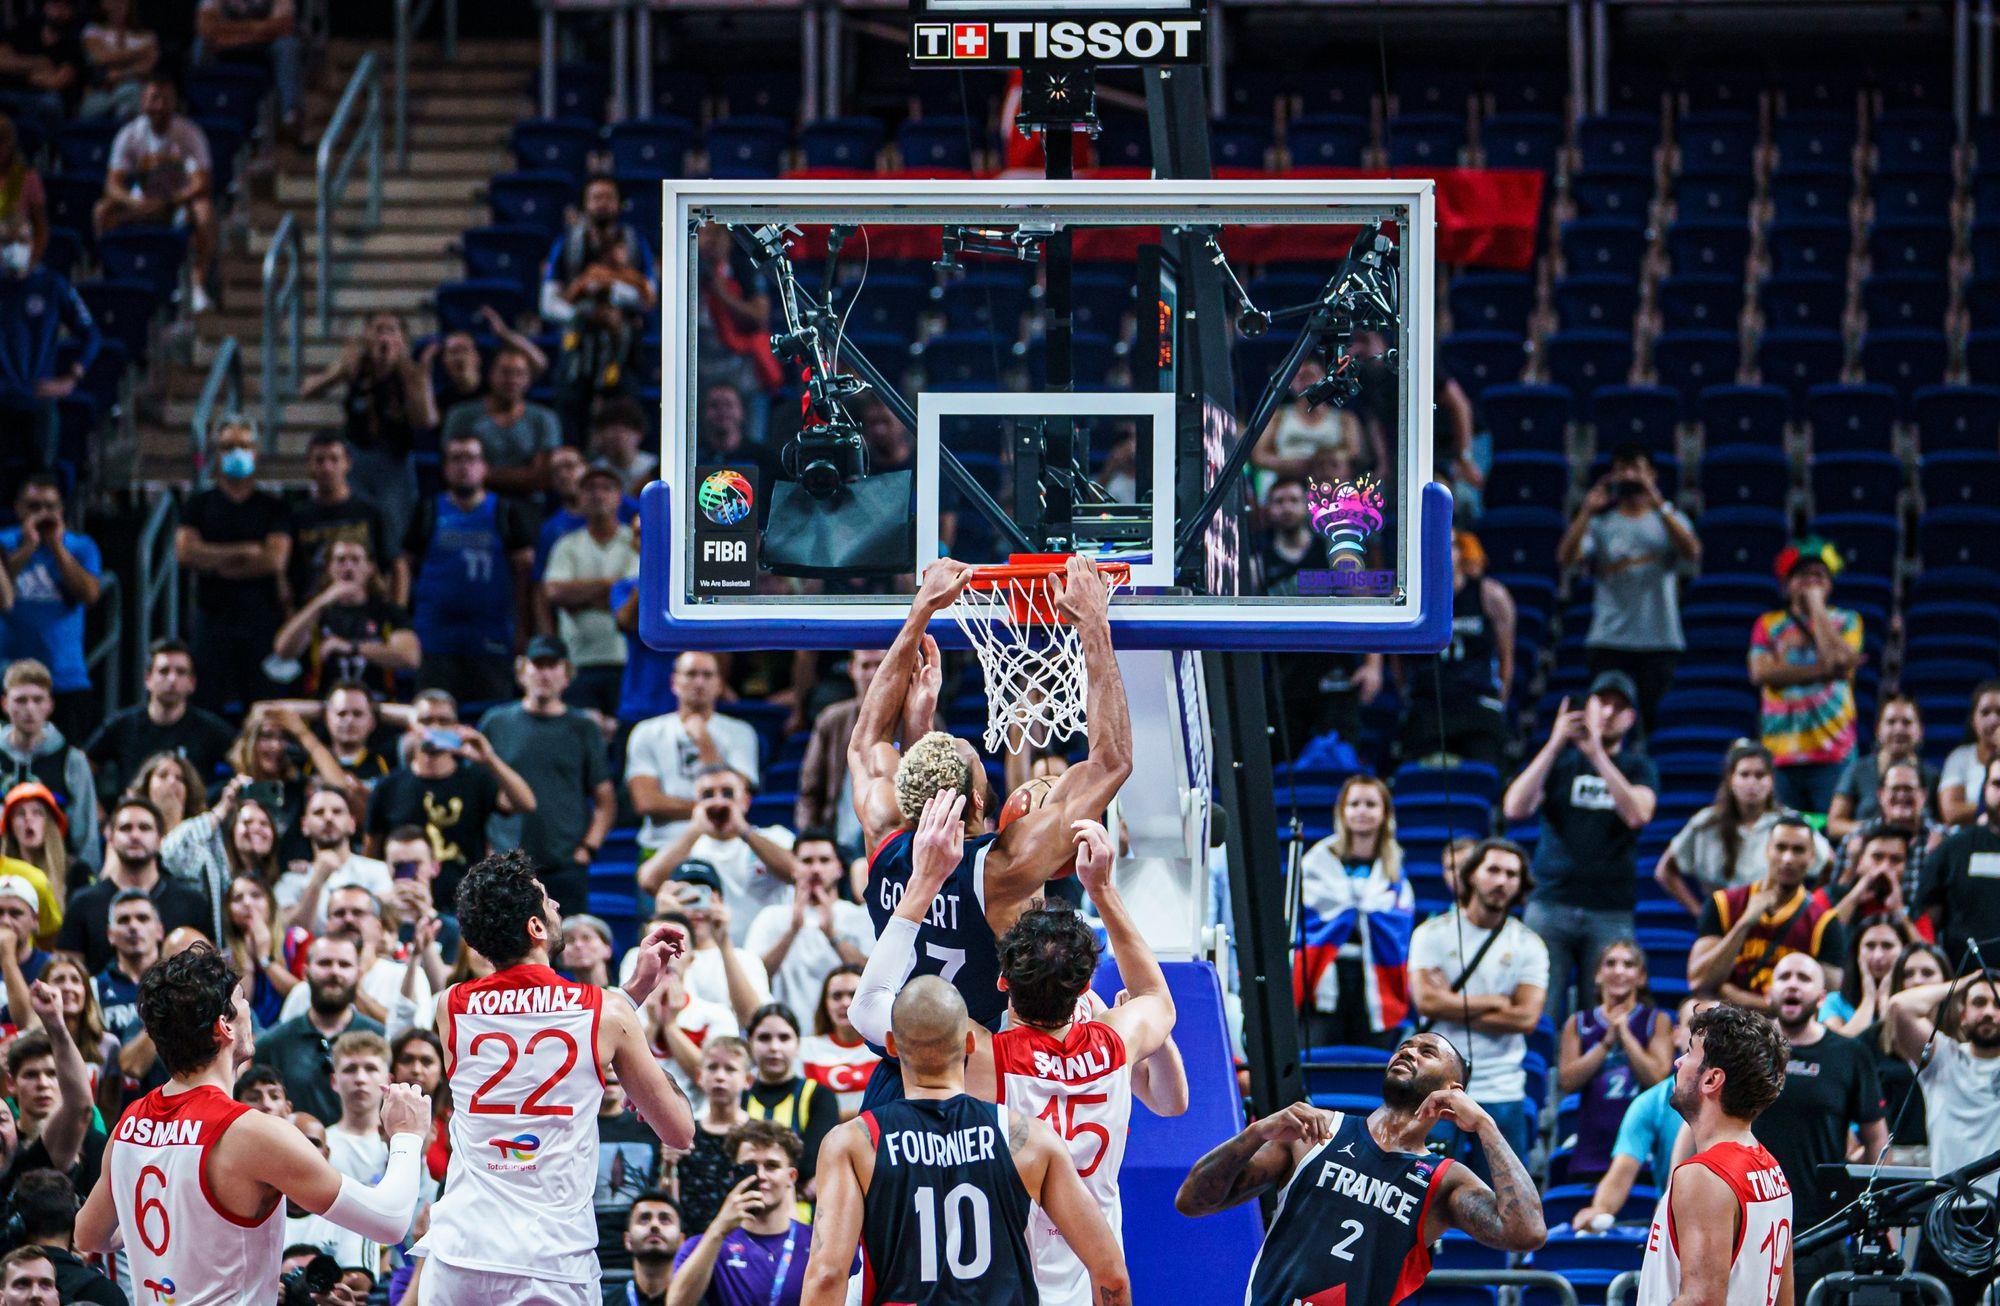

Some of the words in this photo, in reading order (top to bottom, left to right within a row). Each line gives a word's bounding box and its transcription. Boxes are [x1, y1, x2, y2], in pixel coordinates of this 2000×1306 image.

[994, 21, 1201, 59] TISSOT
[703, 540, 747, 562] FIBA
[699, 579, 710, 588] We
[710, 579, 721, 588] Are
[721, 579, 751, 588] Basketball
[880, 876, 960, 930] GORT
[466, 985, 583, 1015] KORKMAZ
[469, 1028, 578, 1116] 22
[119, 1115, 203, 1147] OSMAN
[885, 1125, 995, 1168] FOURNIER
[135, 1164, 170, 1257] 6
[1316, 1160, 1419, 1226] FRANCE
[914, 1182, 991, 1281] 10
[1330, 1219, 1364, 1262] 2
